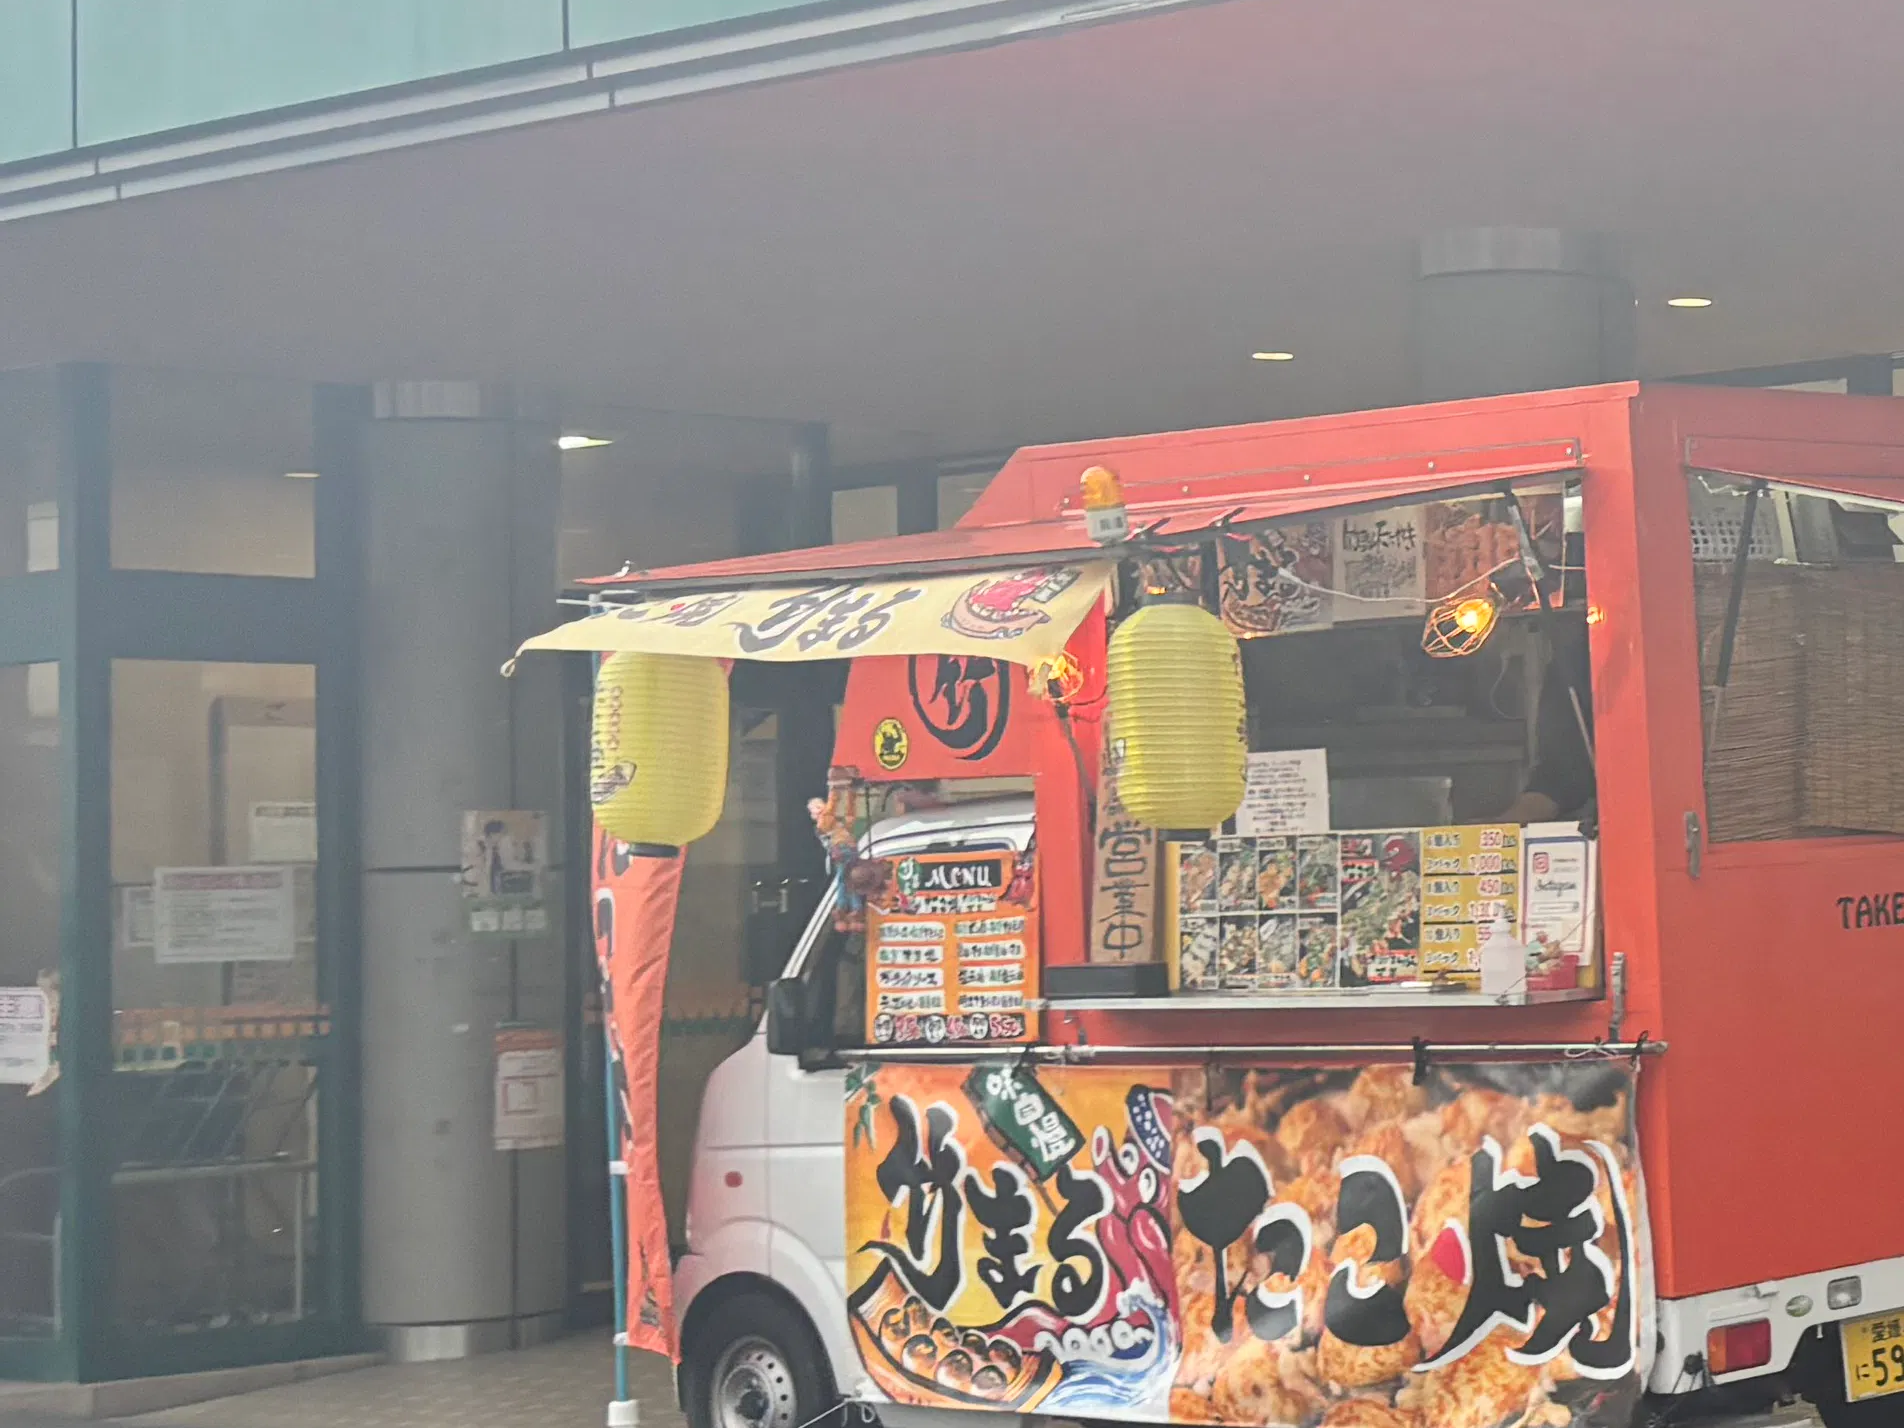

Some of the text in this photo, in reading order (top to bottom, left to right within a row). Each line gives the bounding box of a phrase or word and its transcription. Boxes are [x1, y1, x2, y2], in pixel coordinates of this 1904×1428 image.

[1097, 820, 1153, 959] 営業中
[1177, 1120, 1638, 1382] たこ焼
